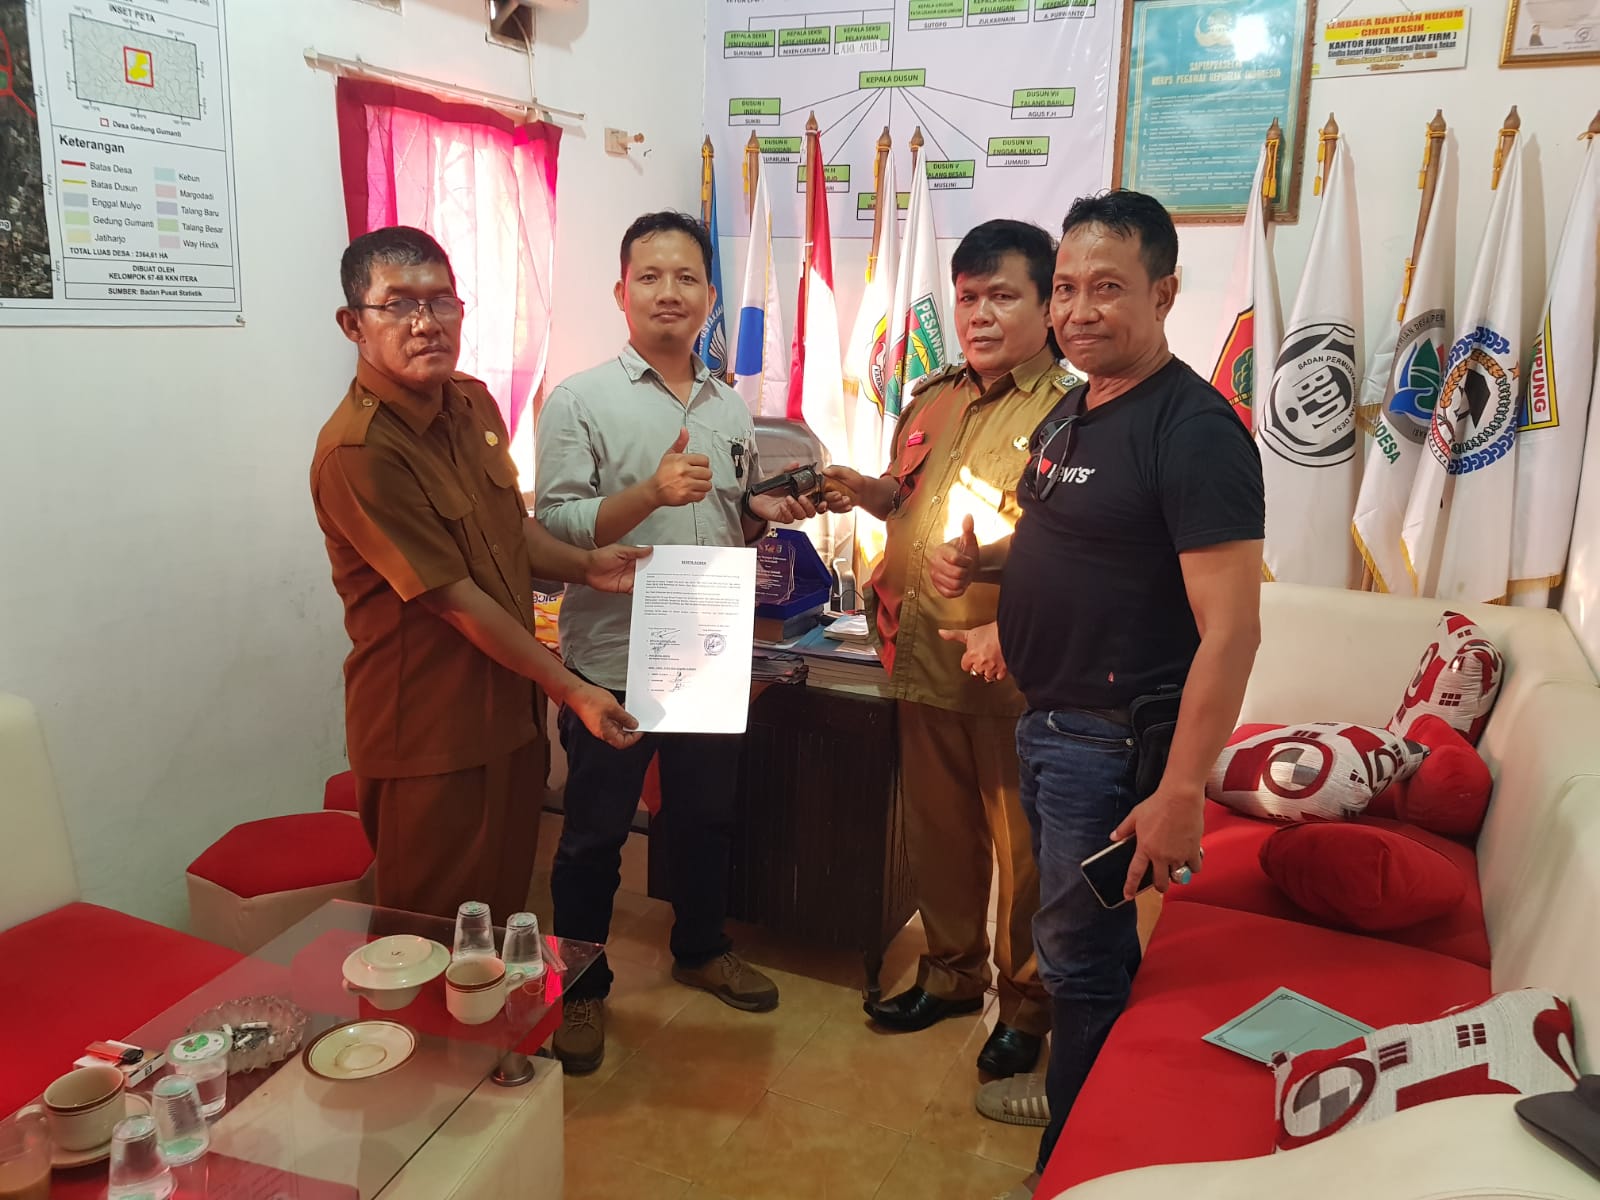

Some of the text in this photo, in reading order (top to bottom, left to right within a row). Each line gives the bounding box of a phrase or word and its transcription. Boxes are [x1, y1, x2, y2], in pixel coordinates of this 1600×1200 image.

[110, 4, 132, 16] INSET
[136, 12, 156, 22] PETA
[1375, 14, 1422, 24] BANTUAN
[1424, 10, 1464, 20] HUKUM
[1361, 28, 1390, 36] CINTA
[1393, 24, 1424, 32] KASIH
[1329, 40, 1364, 50] KANTOR
[1366, 37, 1398, 46] HUKUM
[1406, 34, 1426, 43] LAW
[1428, 32, 1451, 41] FIRM
[866, 74, 919, 84] KEPALA DUSUN
[59, 134, 126, 154] Keterangan
[90, 162, 132, 174] Batas Desa
[179, 173, 200, 182] Kebun
[91, 180, 138, 192] Batas Dusun
[180, 190, 214, 200] Margodadi
[92, 198, 142, 210] Enggal Mulyo
[181, 206, 220, 217] Talang Baru
[93, 216, 122, 227] Gedung
[182, 222, 224, 234] Talang Besar
[94, 234, 126, 244] Jatiharjo
[183, 240, 220, 250] Way Hindik
[140, 288, 160, 296] Badan
[1298, 356, 1324, 370] BADAN
[1332, 419, 1351, 434] DESA
